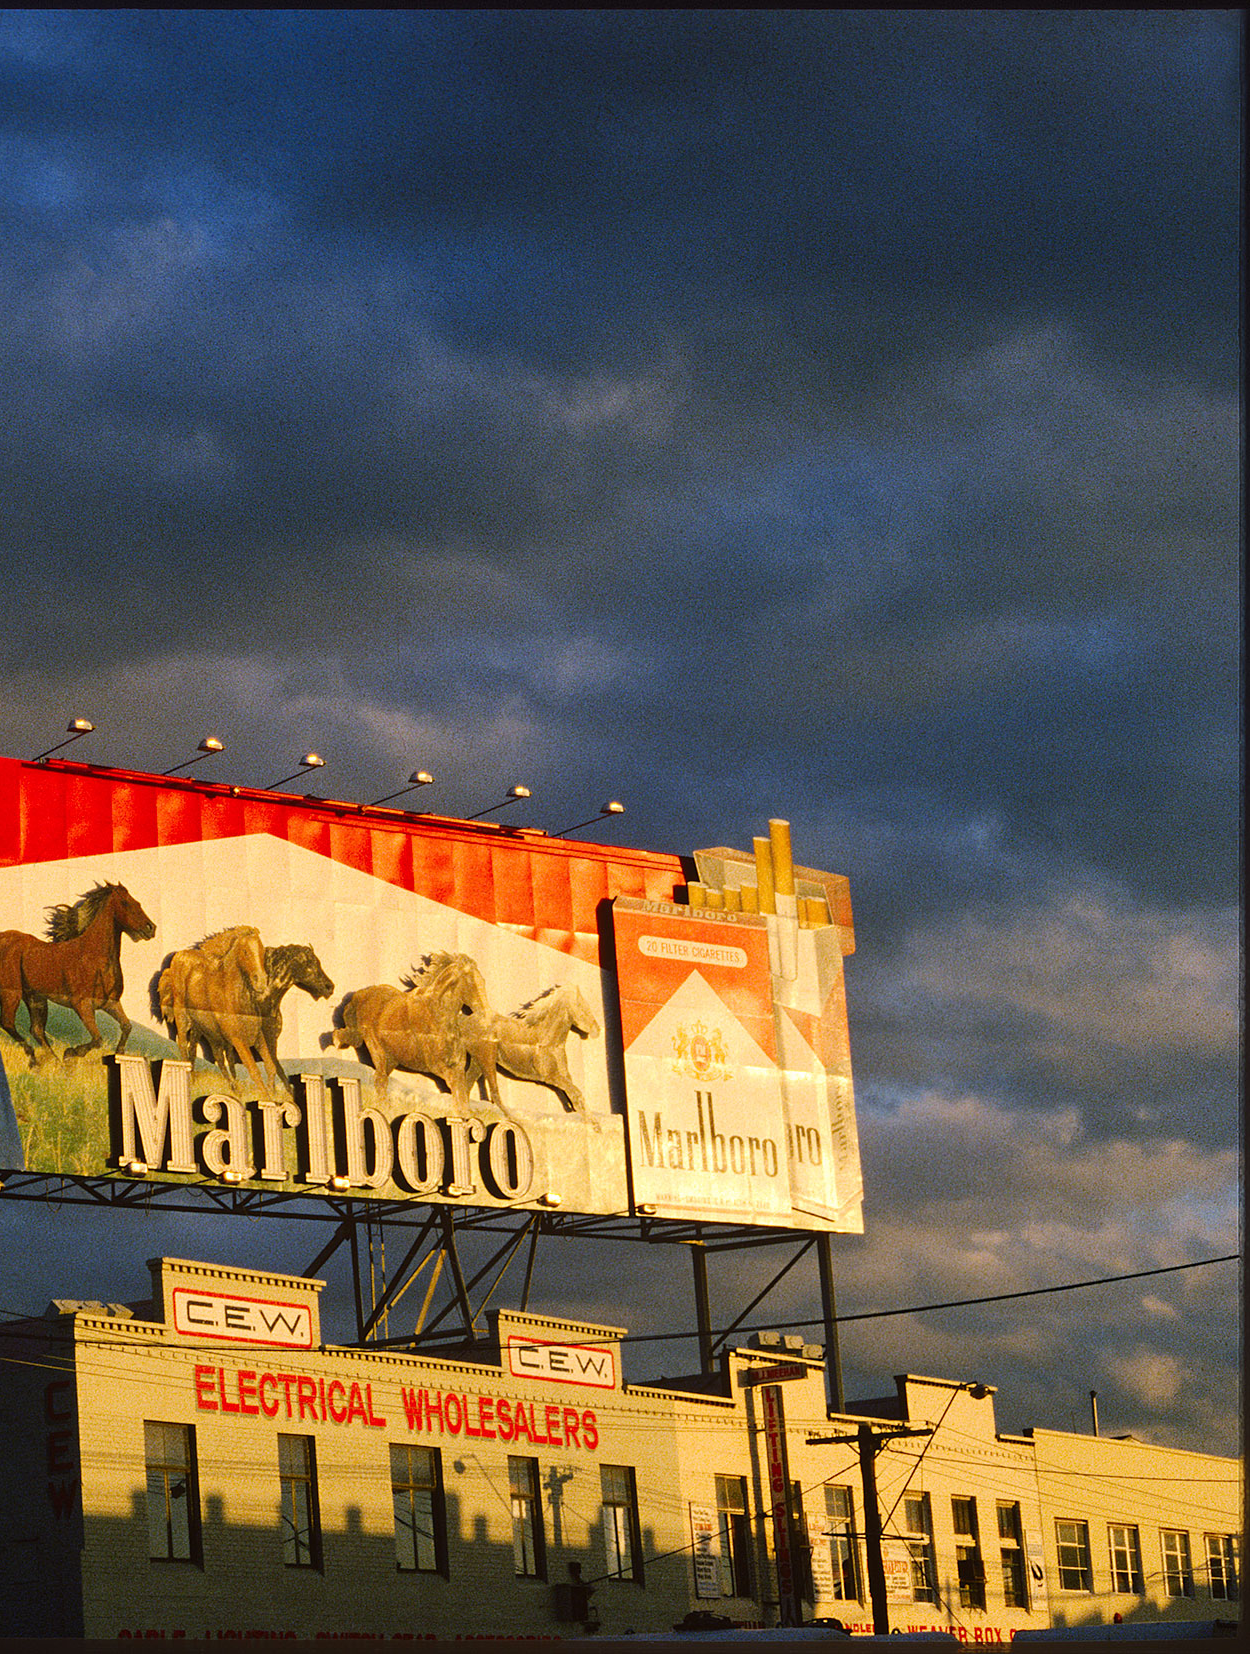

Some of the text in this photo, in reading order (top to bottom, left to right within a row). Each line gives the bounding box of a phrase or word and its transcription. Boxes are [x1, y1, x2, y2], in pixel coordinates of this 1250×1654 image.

[642, 901, 738, 922] Marlboro
[646, 940, 740, 963] 20 FILTER CIGARETTES
[114, 1054, 534, 1199] Marlboro
[638, 1089, 779, 1178] Marlboro
[186, 1300, 304, 1337] C.E.W.
[519, 1347, 608, 1378] C.E.W.
[194, 1364, 599, 1451] ELECTRICAL WHOLESALERS
[764, 1387, 794, 1595] LIFTING SLINGS
[974, 1627, 1003, 1646] BOX
